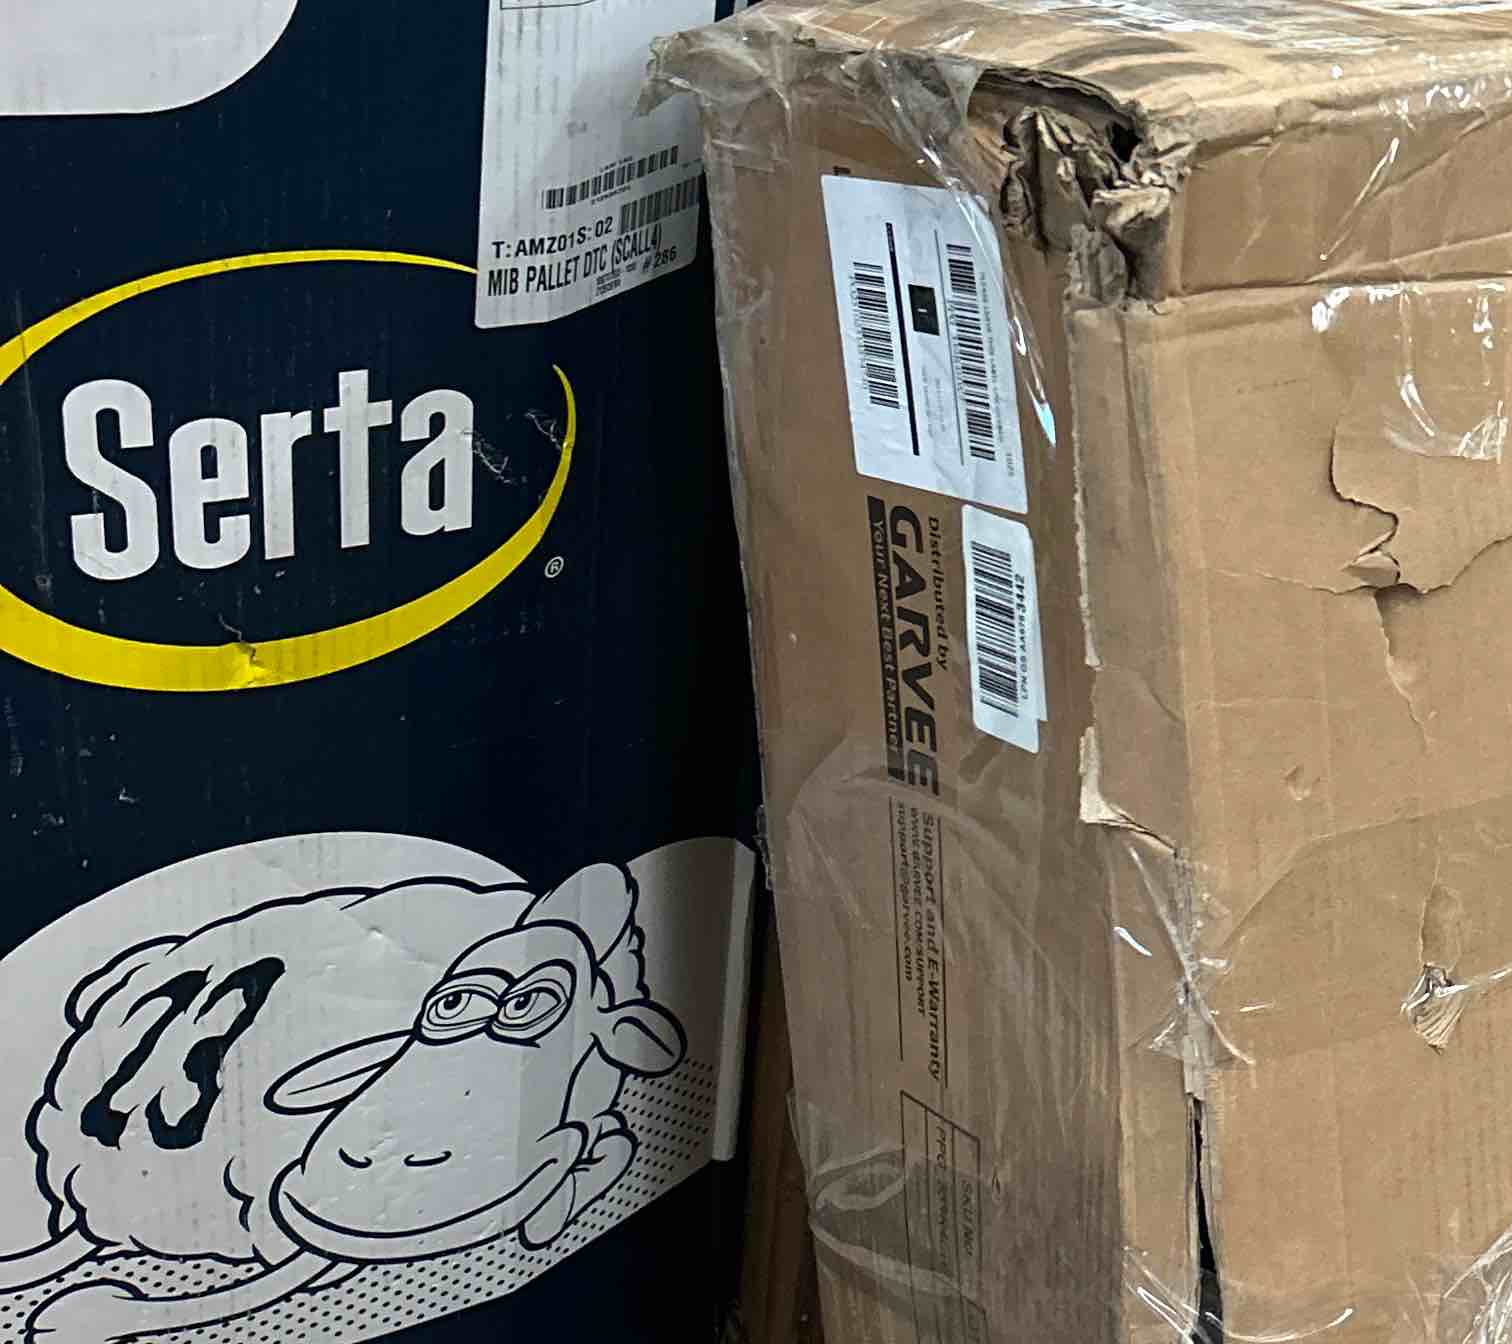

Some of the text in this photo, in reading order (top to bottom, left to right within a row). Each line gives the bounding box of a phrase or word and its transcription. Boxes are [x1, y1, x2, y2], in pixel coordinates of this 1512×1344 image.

[487, 267, 519, 298] MIB
[525, 250, 581, 295] PALLET
[583, 244, 609, 276] DTC
[610, 223, 663, 272] (SCALL4)
[62, 369, 474, 581] Serta
[871, 519, 890, 565] Your
[876, 572, 894, 620] Next
[928, 516, 950, 672] Distributed by
[889, 505, 940, 796] GARVEE
[885, 678, 901, 753] Partner
[920, 812, 942, 1082] Support and E-Warranty
